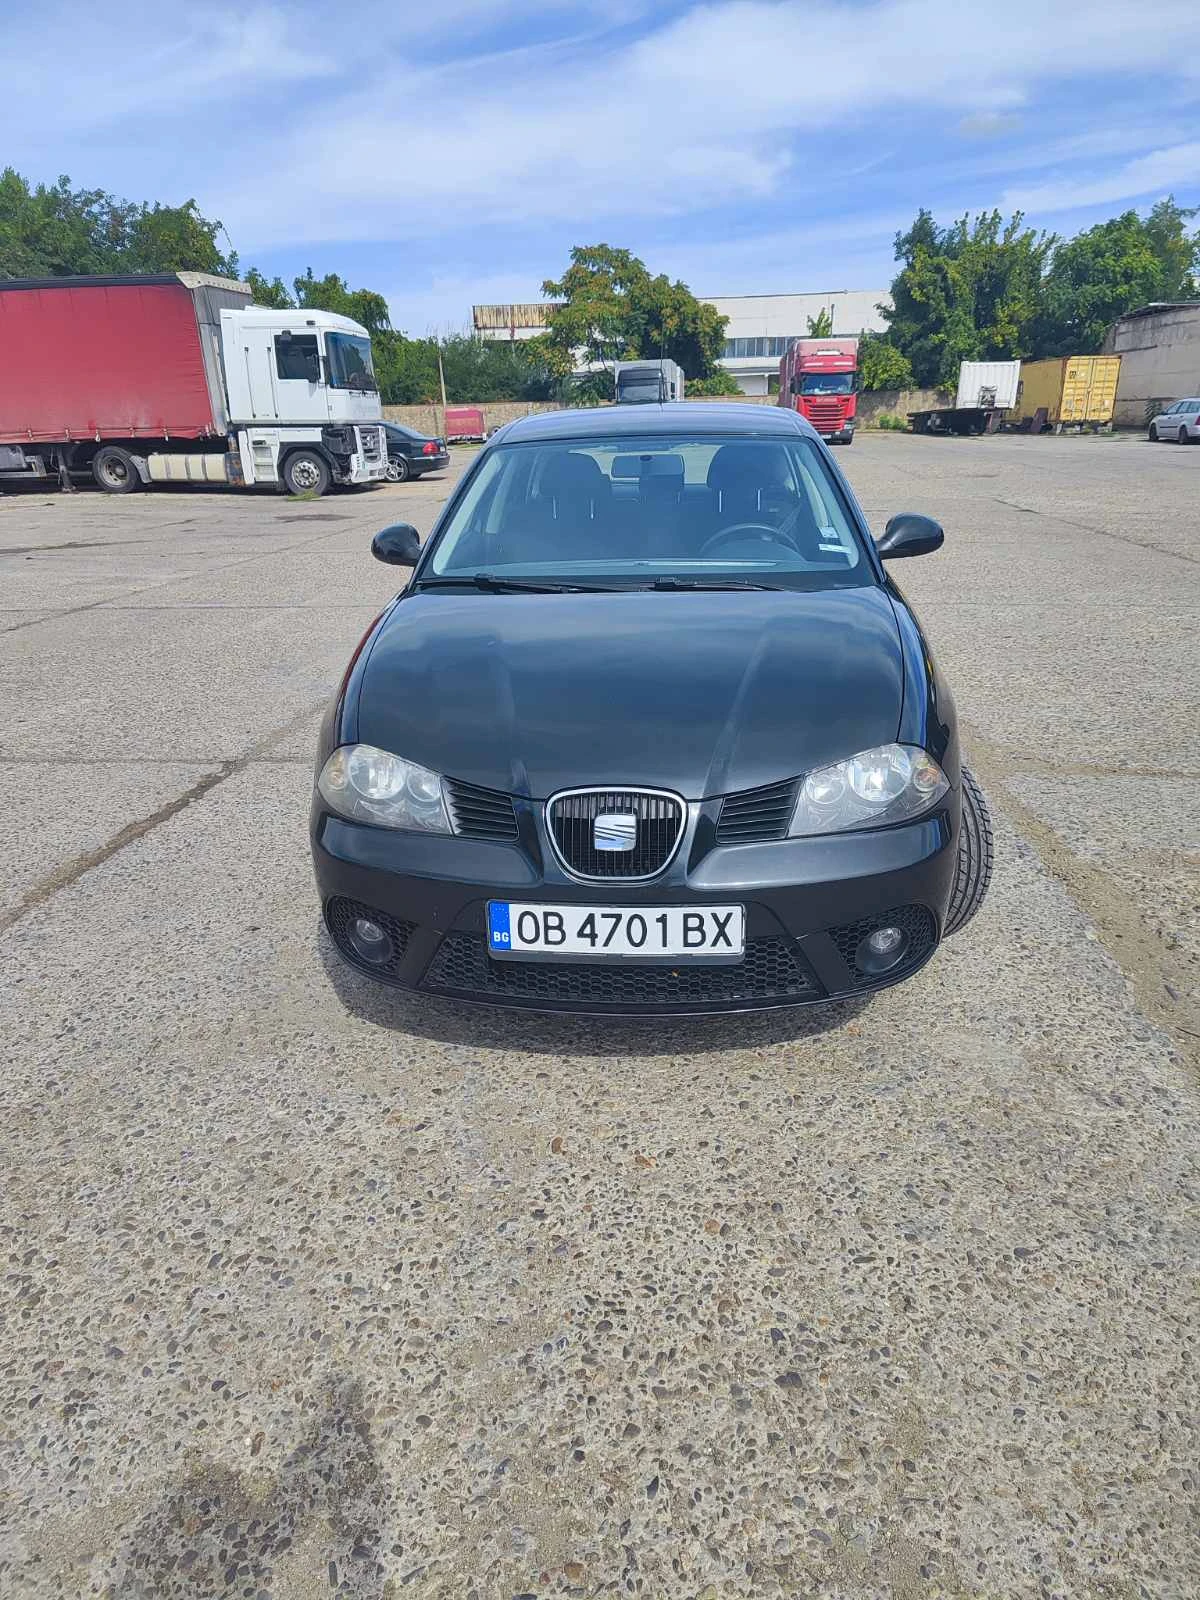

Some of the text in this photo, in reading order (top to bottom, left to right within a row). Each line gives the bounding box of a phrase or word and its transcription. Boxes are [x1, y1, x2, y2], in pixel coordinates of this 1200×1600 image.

[493, 931, 510, 943] BG
[517, 910, 733, 948] OB 4701 BX
